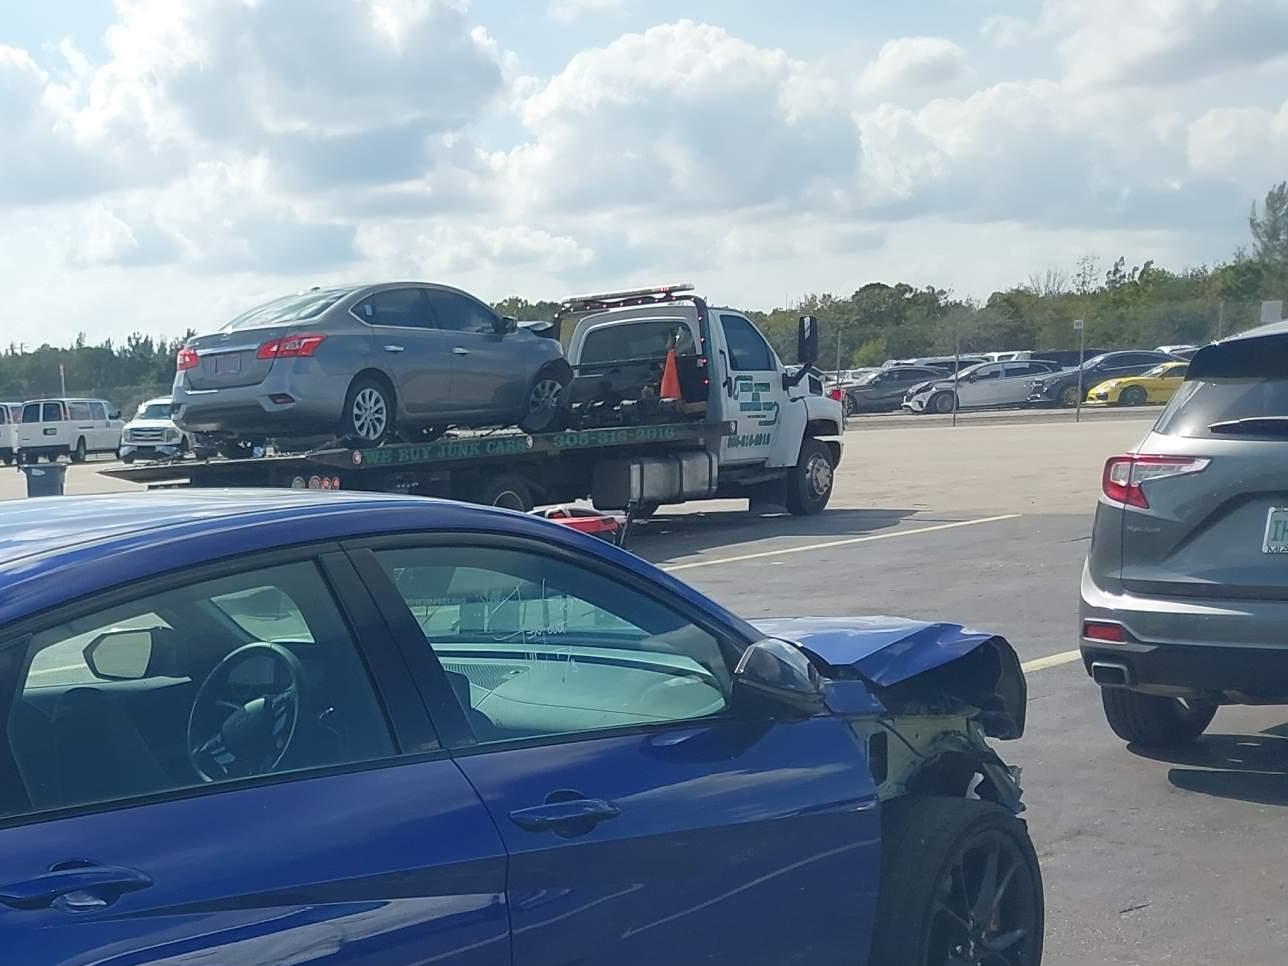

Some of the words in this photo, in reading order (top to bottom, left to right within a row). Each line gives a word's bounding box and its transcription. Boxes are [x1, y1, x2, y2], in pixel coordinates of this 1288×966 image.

[363, 449, 393, 466] WE
[398, 446, 432, 462] BUY
[439, 440, 481, 458] JUNK
[487, 437, 526, 455] CARS
